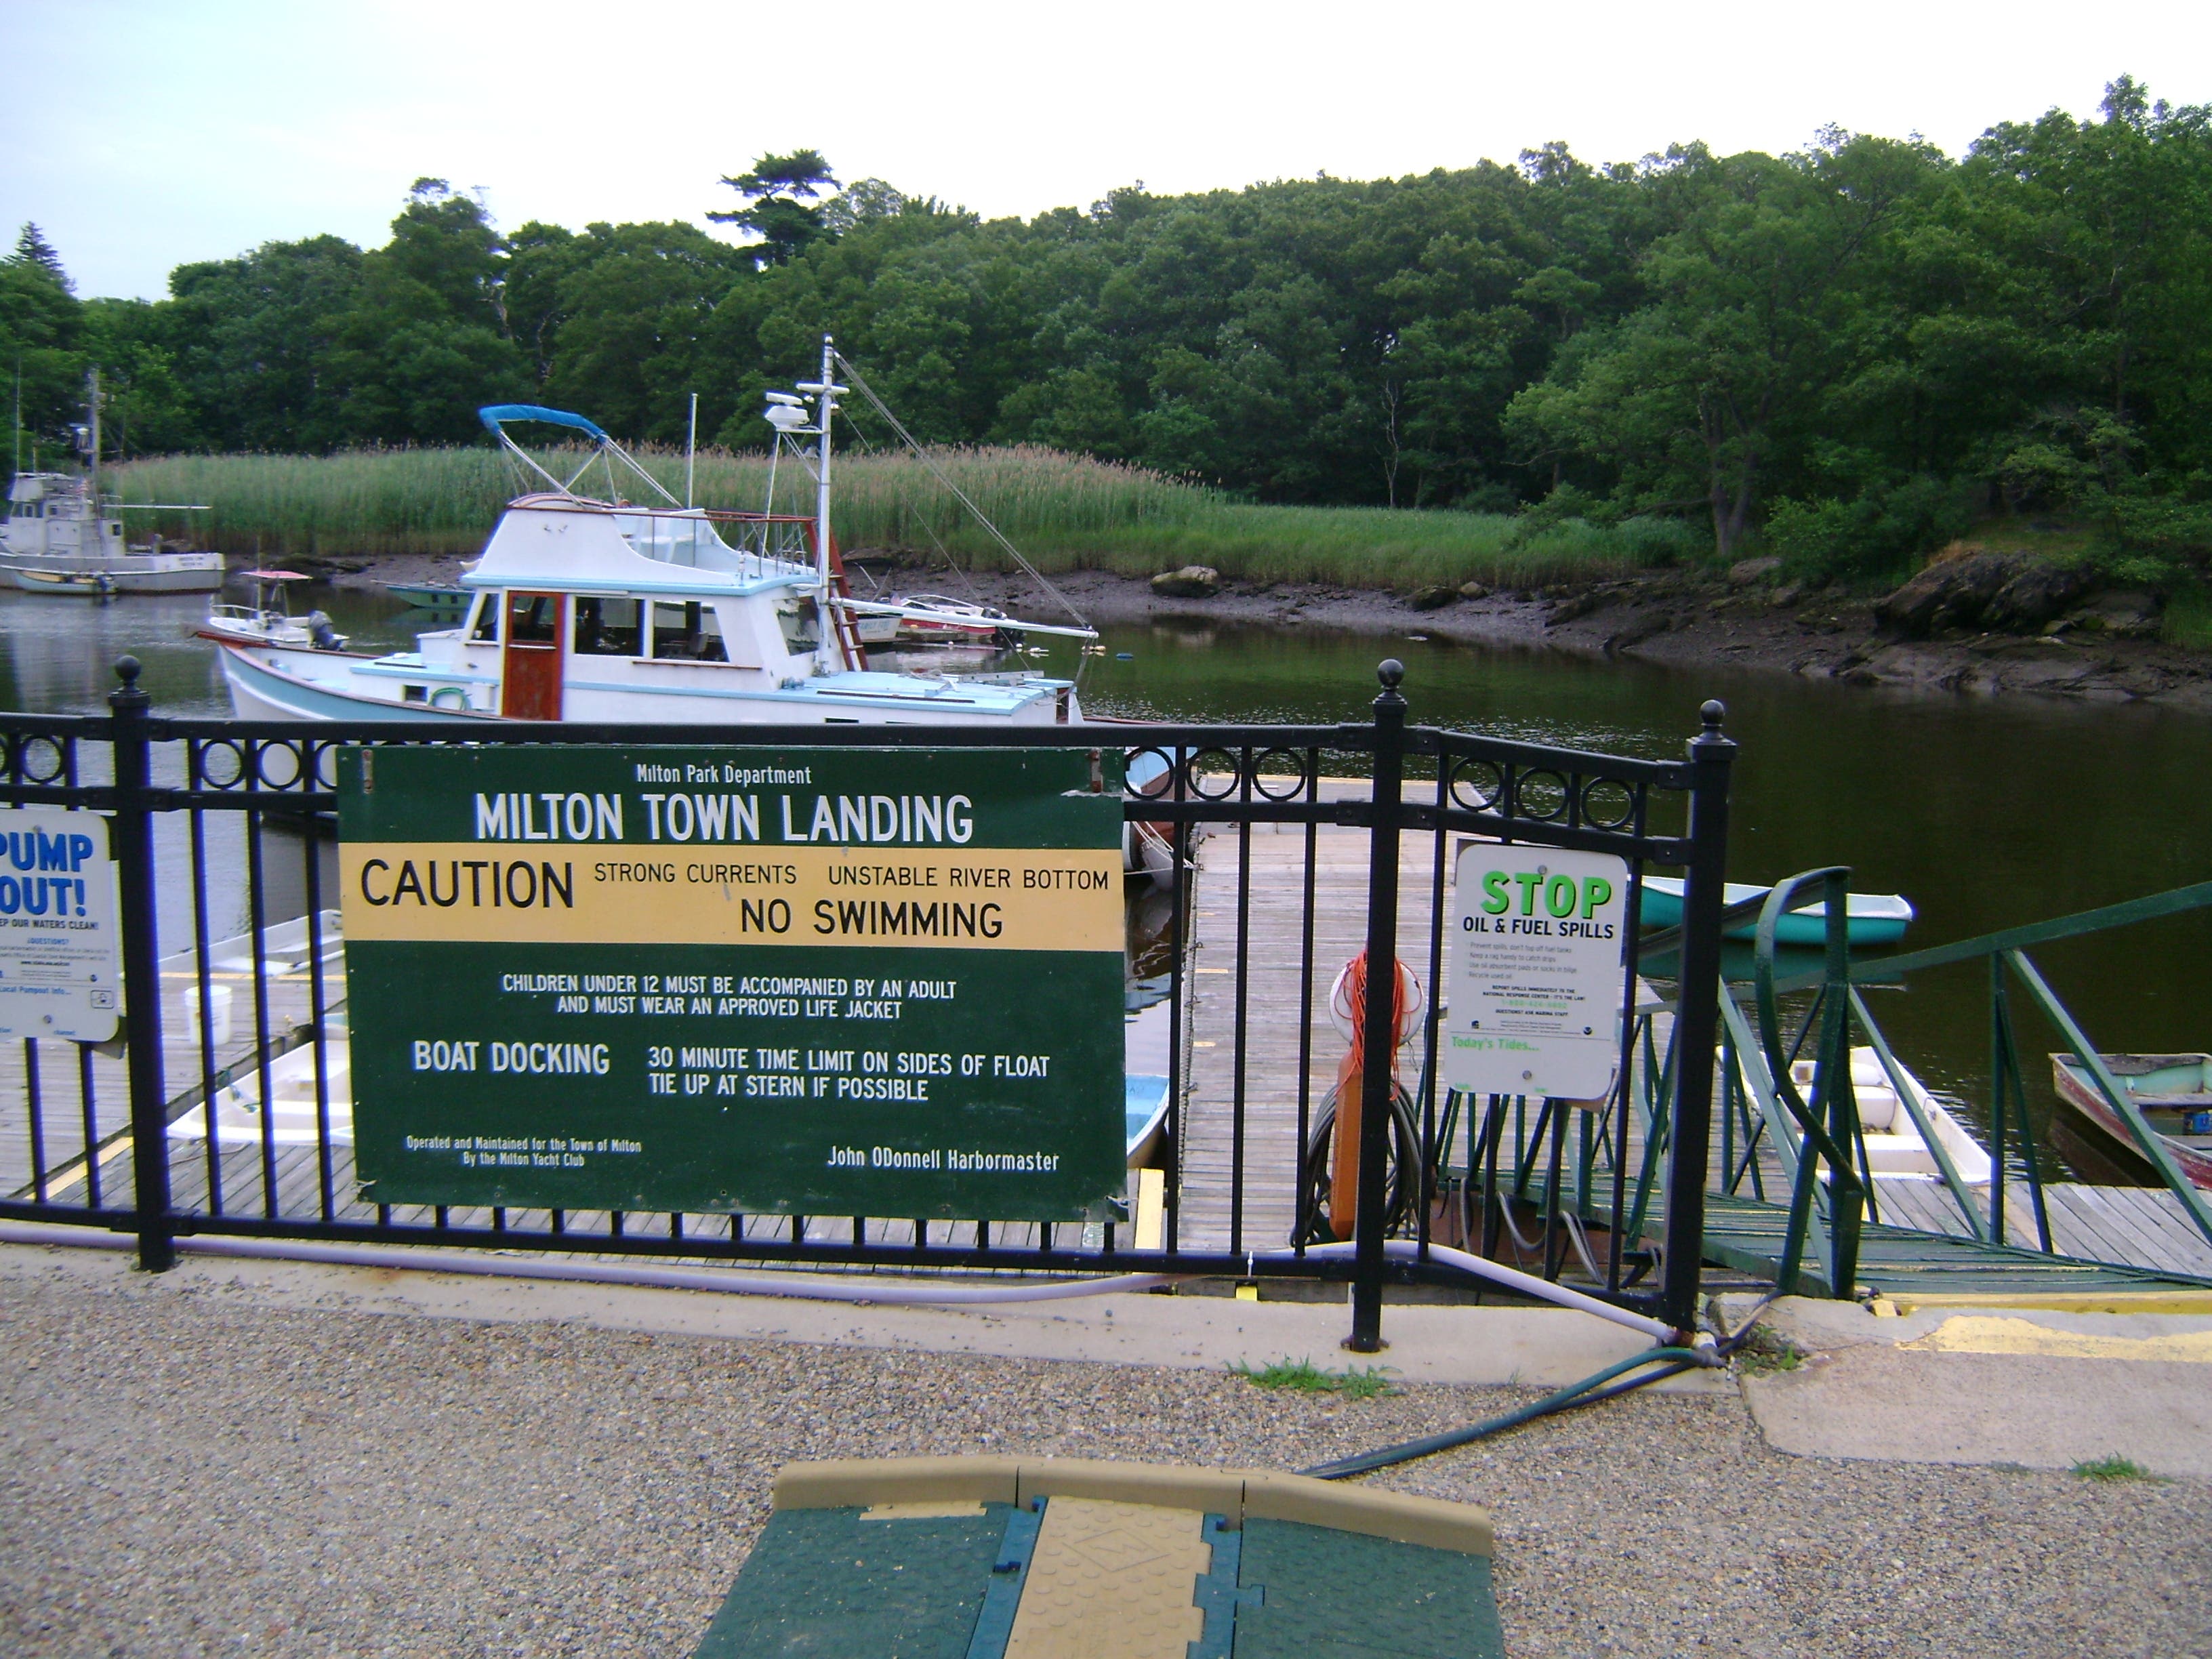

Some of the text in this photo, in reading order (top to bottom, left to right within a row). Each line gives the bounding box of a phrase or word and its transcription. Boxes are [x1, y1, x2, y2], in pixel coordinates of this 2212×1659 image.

[637, 764, 811, 787] Milton Park Department
[476, 793, 972, 843] MILTON TOWN LANDING
[362, 859, 573, 907] CAUTION
[595, 863, 1107, 889] STRONG CURRENTS UNSTABLE RIVER BOTTOM
[0, 876, 86, 916] OUT!
[1480, 870, 1612, 920] STOP
[12, 919, 29, 928] OUR
[33, 920, 65, 929] WATERS
[742, 899, 1002, 938] NO SWIMMING
[1463, 916, 1614, 939] OIL & FUEL SPILLS
[504, 974, 956, 998] CHILDREN UNDER 12 MUST BE ACCOMPANIED BY AN ADULT
[558, 996, 901, 1019] AND MUST WEAR AN APPROVED LIFE JACKET
[1452, 1036, 1493, 1050] Today's
[415, 1040, 609, 1073] BOAT DOCKING
[649, 1046, 1050, 1076] 30 MINUTE TIME LIMIT ON SIDES OF FLOAT
[649, 1073, 928, 1101] TIE UP AT STERN IF POSSIBLE
[407, 1135, 641, 1152] Operated and Maintained for the Town of Milton
[464, 1151, 584, 1168] By the Milton Yacht Club
[828, 1146, 1059, 1170] John ODonnell Harbormaster
